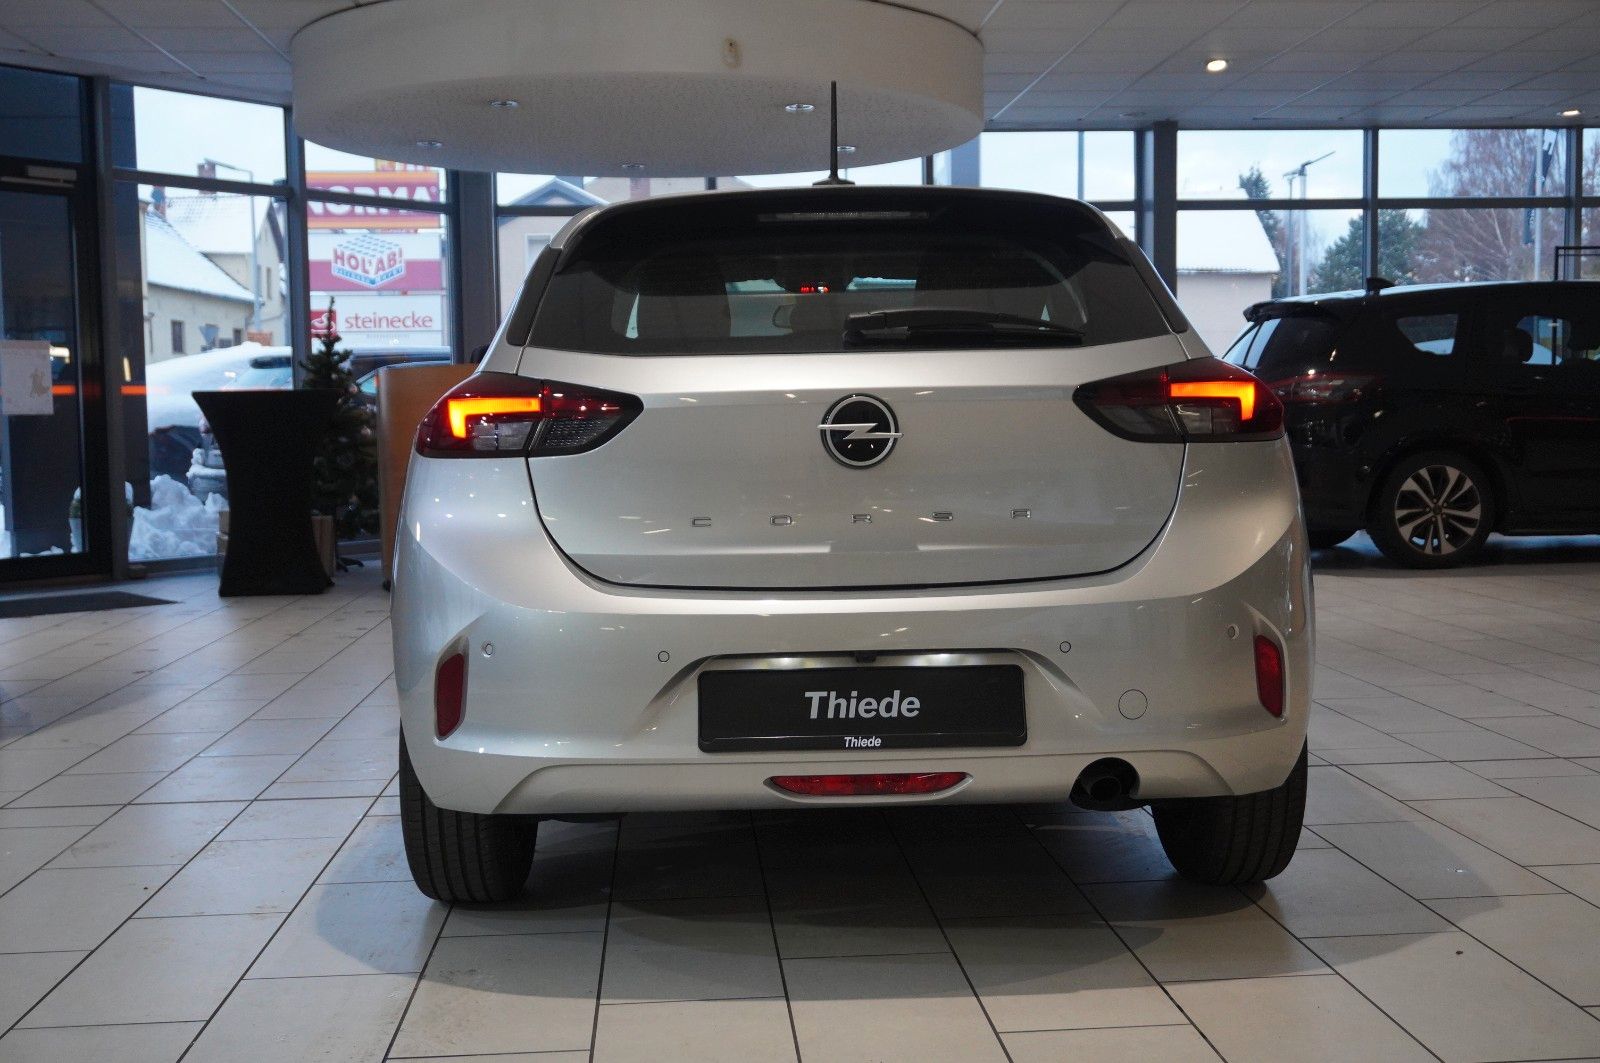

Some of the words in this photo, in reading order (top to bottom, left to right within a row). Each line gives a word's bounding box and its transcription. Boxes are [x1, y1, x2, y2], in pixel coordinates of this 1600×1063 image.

[344, 311, 433, 329] steinecke
[691, 508, 1032, 528] CORSA
[804, 689, 921, 719] Thiede
[844, 736, 882, 748] Thiede
